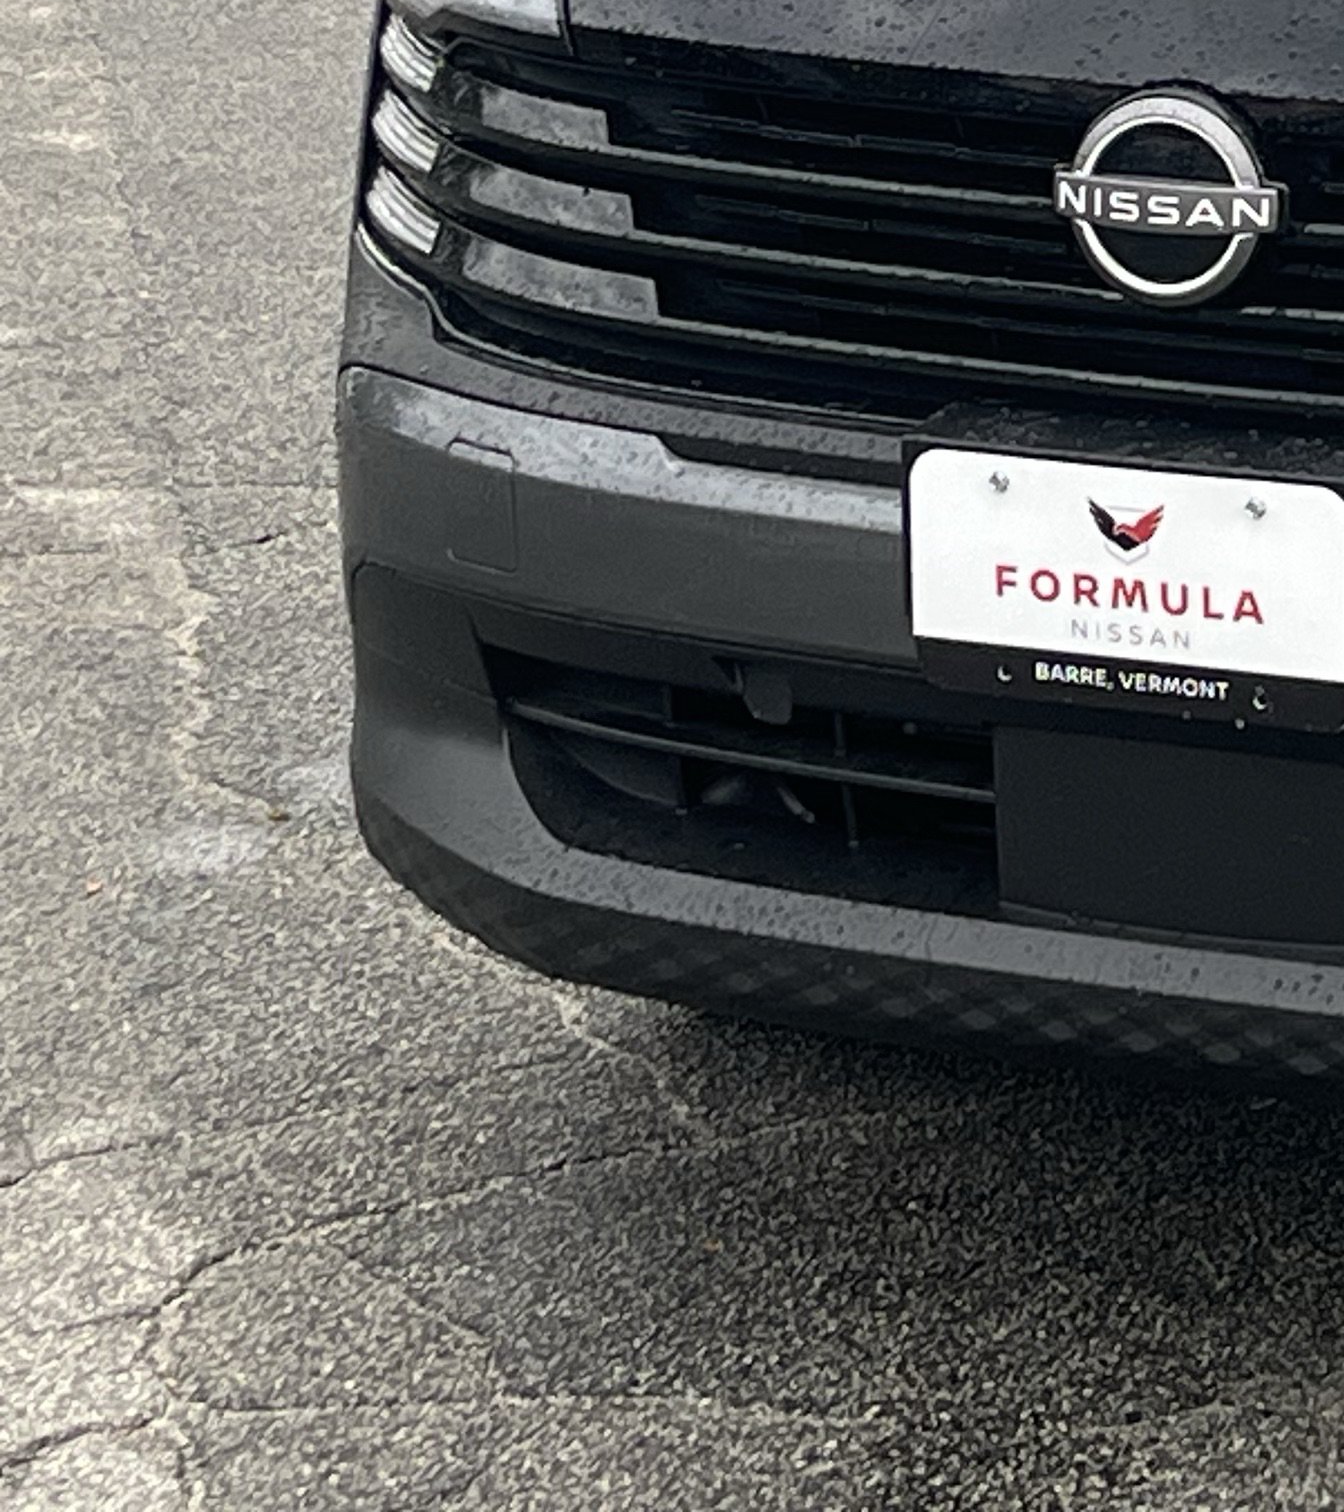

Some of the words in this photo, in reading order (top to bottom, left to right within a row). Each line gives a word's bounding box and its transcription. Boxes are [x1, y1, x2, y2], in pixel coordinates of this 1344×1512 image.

[1058, 180, 1270, 227] NISSAN
[995, 564, 1265, 625] FORMULA
[1070, 617, 1191, 651] NISSAN
[1034, 661, 1115, 691] BARRE,
[1118, 670, 1230, 701] VERMONT
